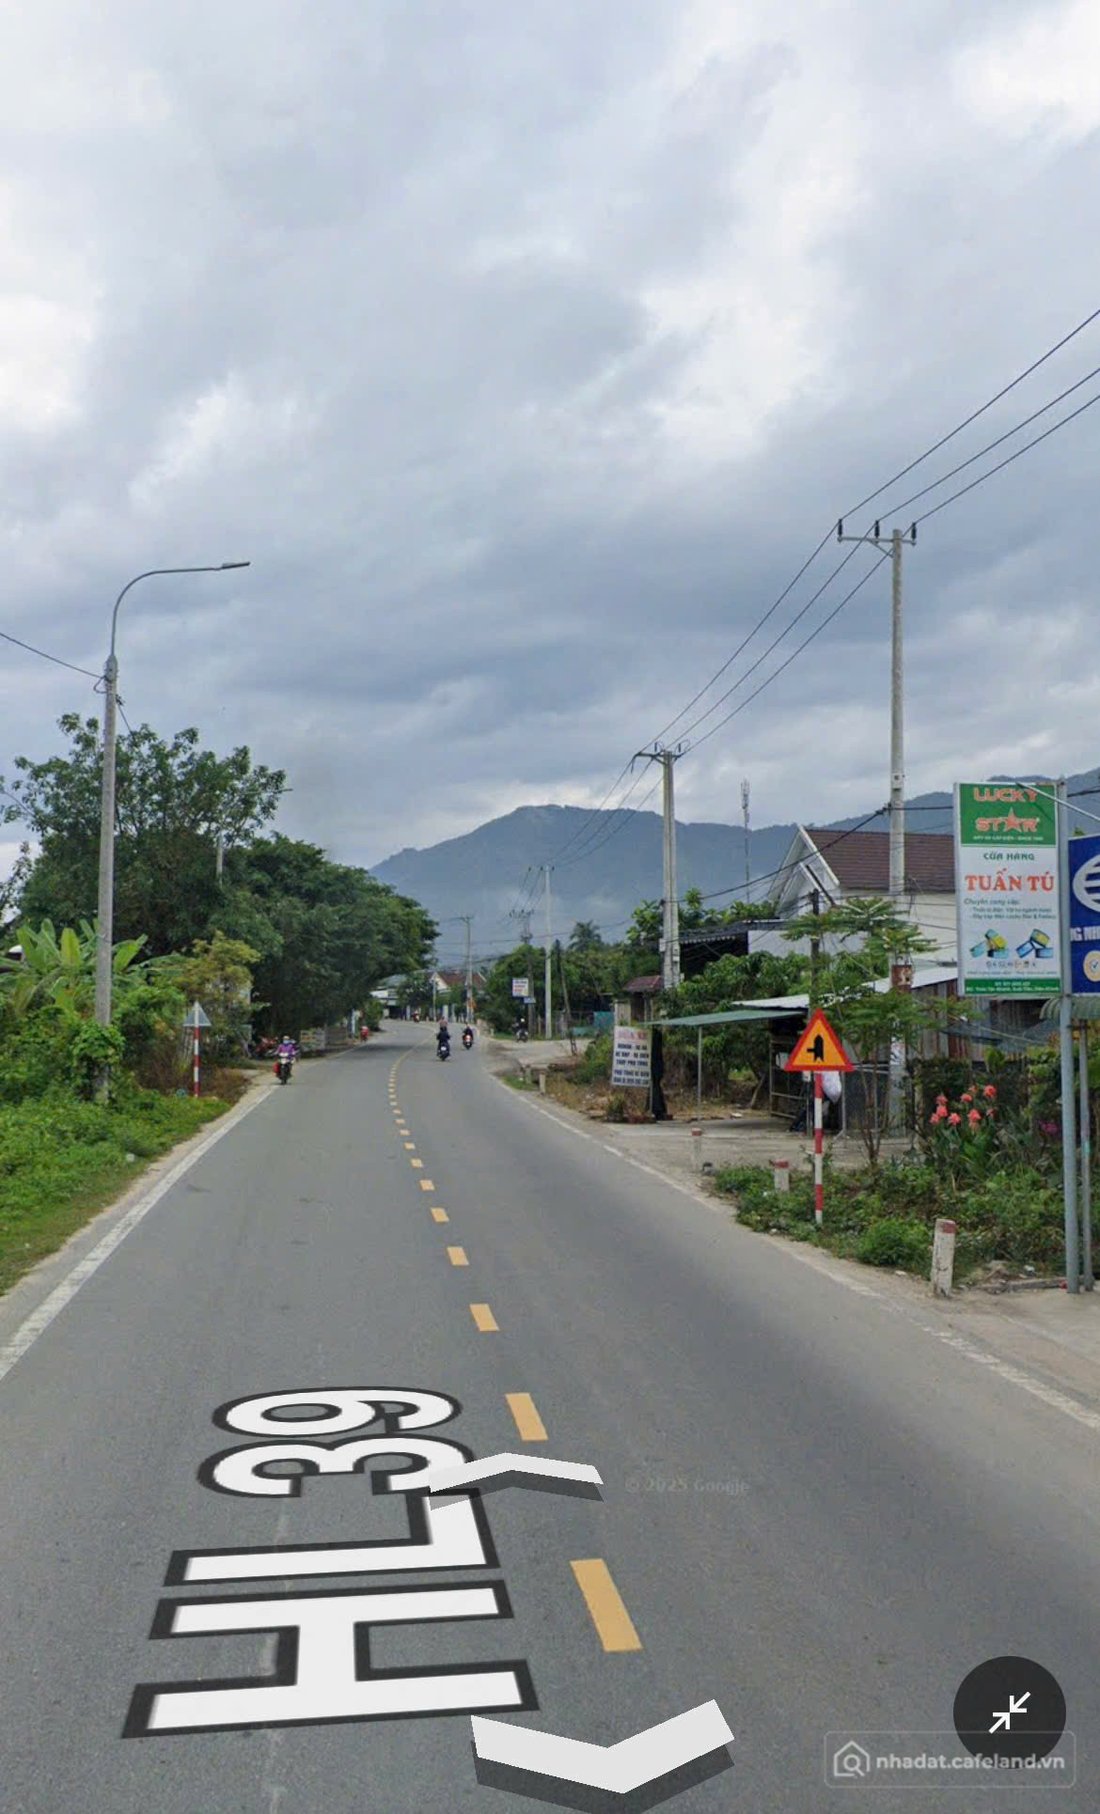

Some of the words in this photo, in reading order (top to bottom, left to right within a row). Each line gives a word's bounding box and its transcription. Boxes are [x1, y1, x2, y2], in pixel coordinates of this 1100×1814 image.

[973, 787, 1038, 802] LUCKY
[975, 806, 1037, 833] STAR
[964, 868, 1022, 891] TUẤN
[1027, 871, 1055, 892] TÚ
